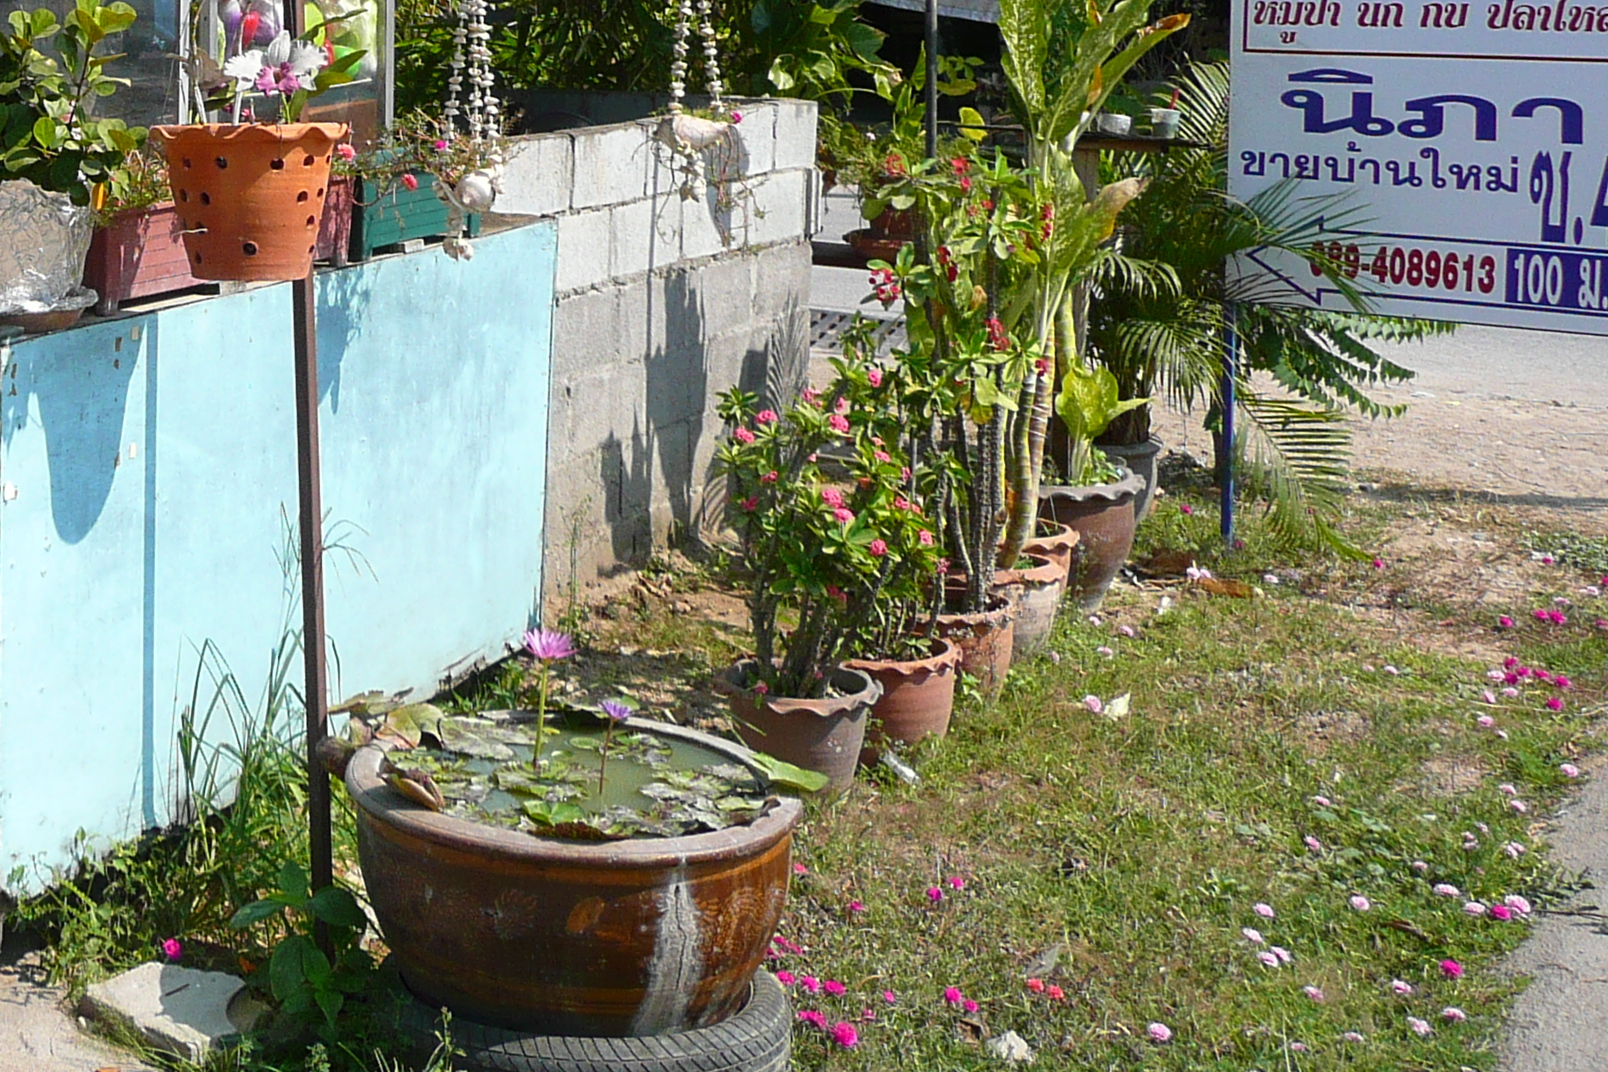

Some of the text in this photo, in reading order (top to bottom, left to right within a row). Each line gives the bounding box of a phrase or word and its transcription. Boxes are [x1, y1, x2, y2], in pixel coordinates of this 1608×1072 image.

[1357, 0, 1404, 29] นก
[1419, 0, 1470, 30] กบ
[1279, 67, 1585, 146] นิภา
[1240, 140, 1520, 194] ขายบ้านใหม่
[1514, 253, 1564, 306] 100
